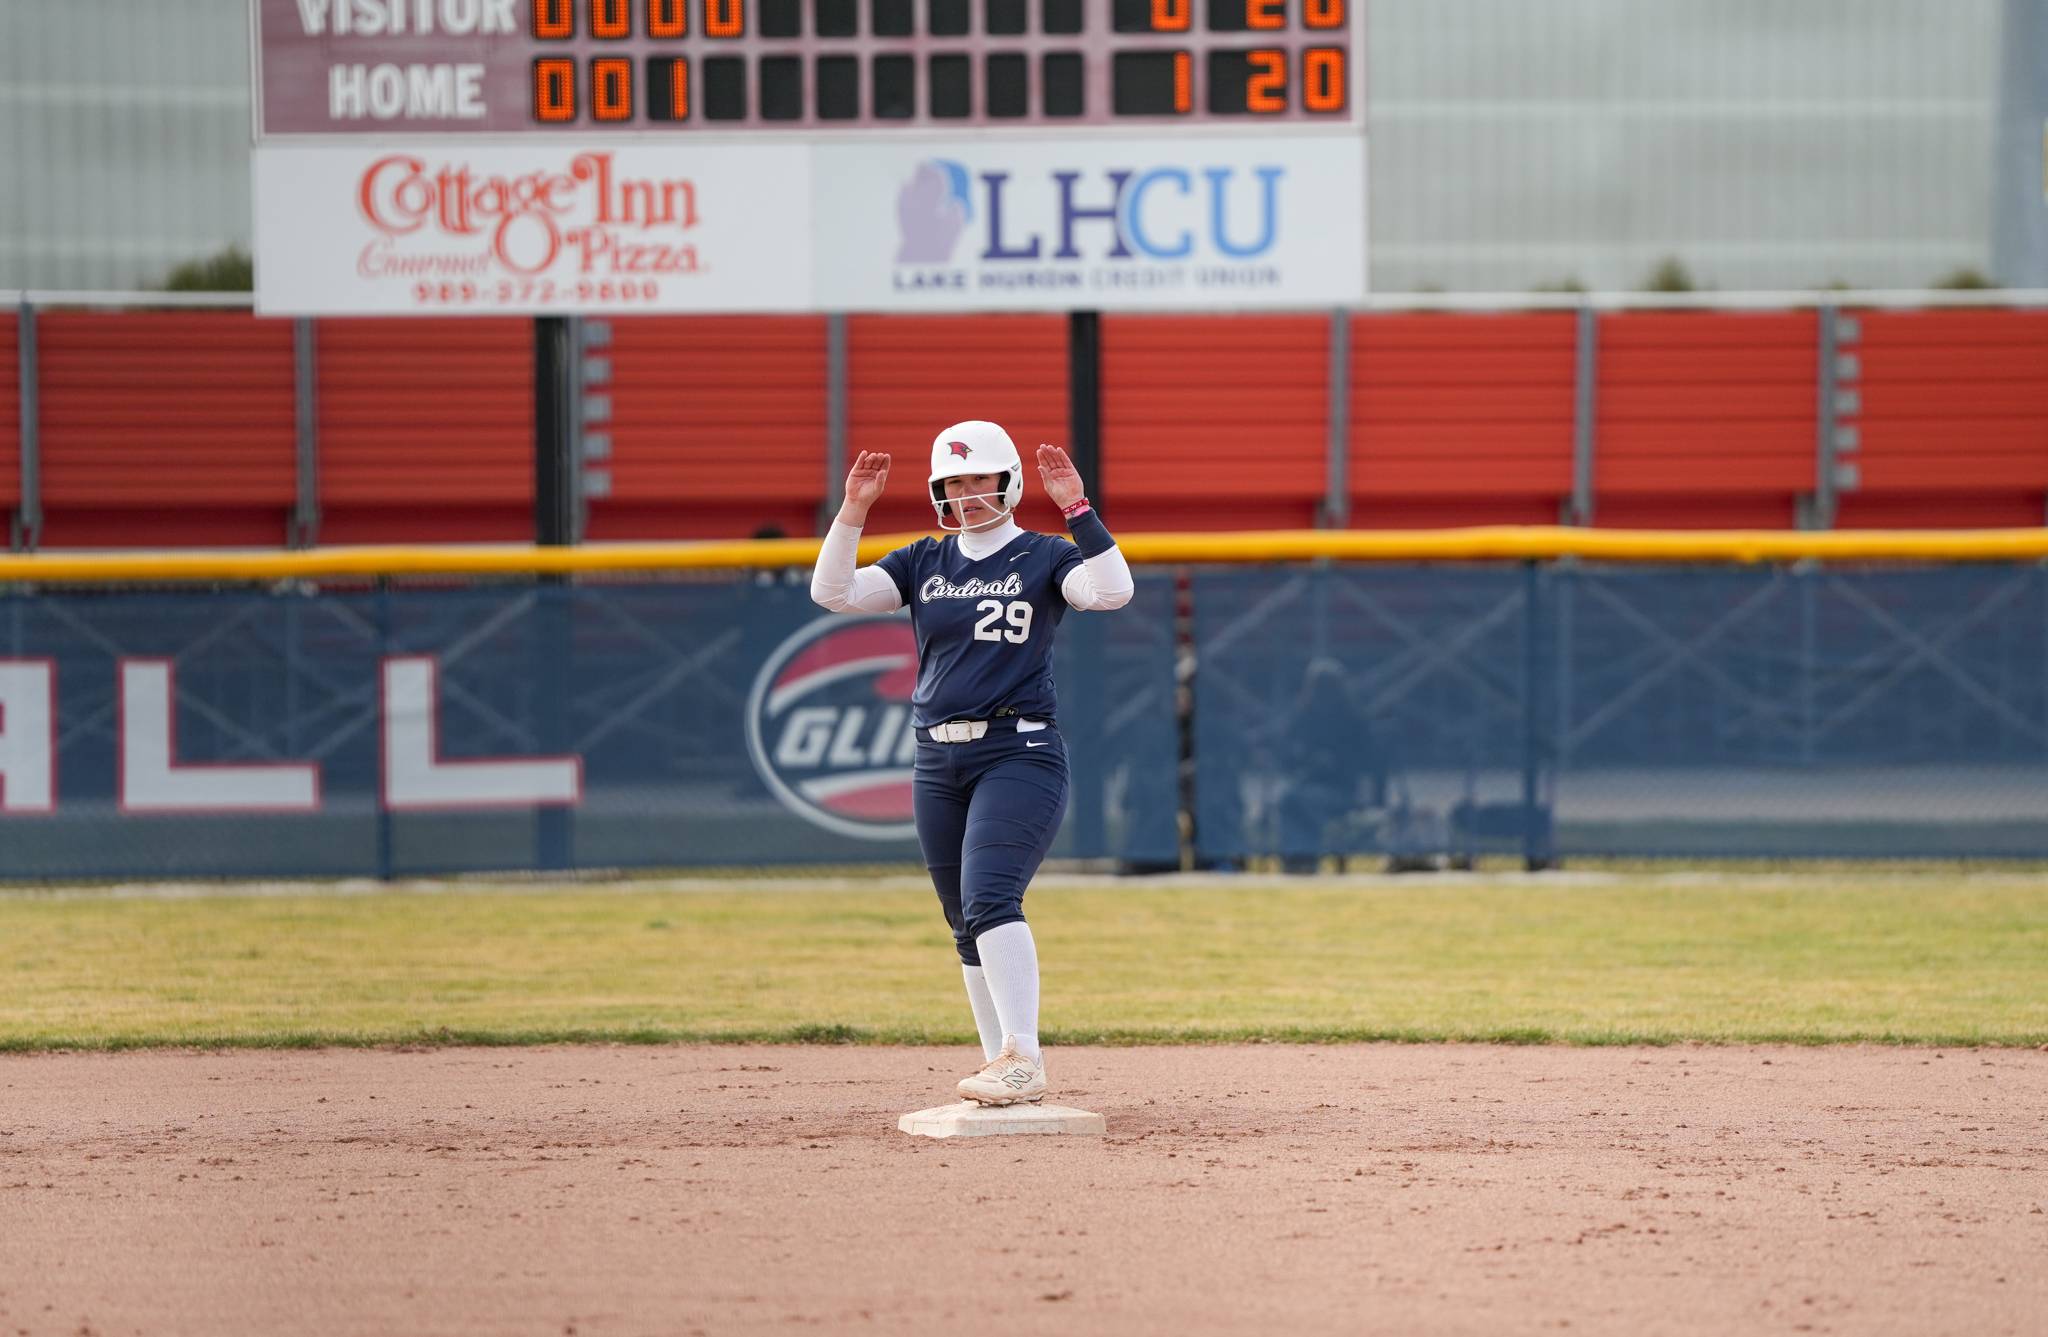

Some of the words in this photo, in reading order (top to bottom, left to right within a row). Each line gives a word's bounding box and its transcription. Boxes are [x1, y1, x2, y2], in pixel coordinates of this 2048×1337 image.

[298, 0, 516, 36] VISITOR
[329, 63, 486, 120] HOME
[534, 59, 574, 121] 0
[591, 59, 631, 121] 0
[668, 58, 688, 120] 1
[1173, 51, 1192, 113] 1
[358, 154, 577, 274] Cottage
[571, 150, 701, 228] Inn
[979, 166, 1285, 259] LHCU
[893, 267, 968, 290] LAKE
[979, 267, 1084, 289] HURON
[1092, 265, 1187, 288] CREDIT
[1195, 264, 1282, 287] UNION
[919, 573, 1023, 604] Cardinals
[974, 599, 1033, 644] 29
